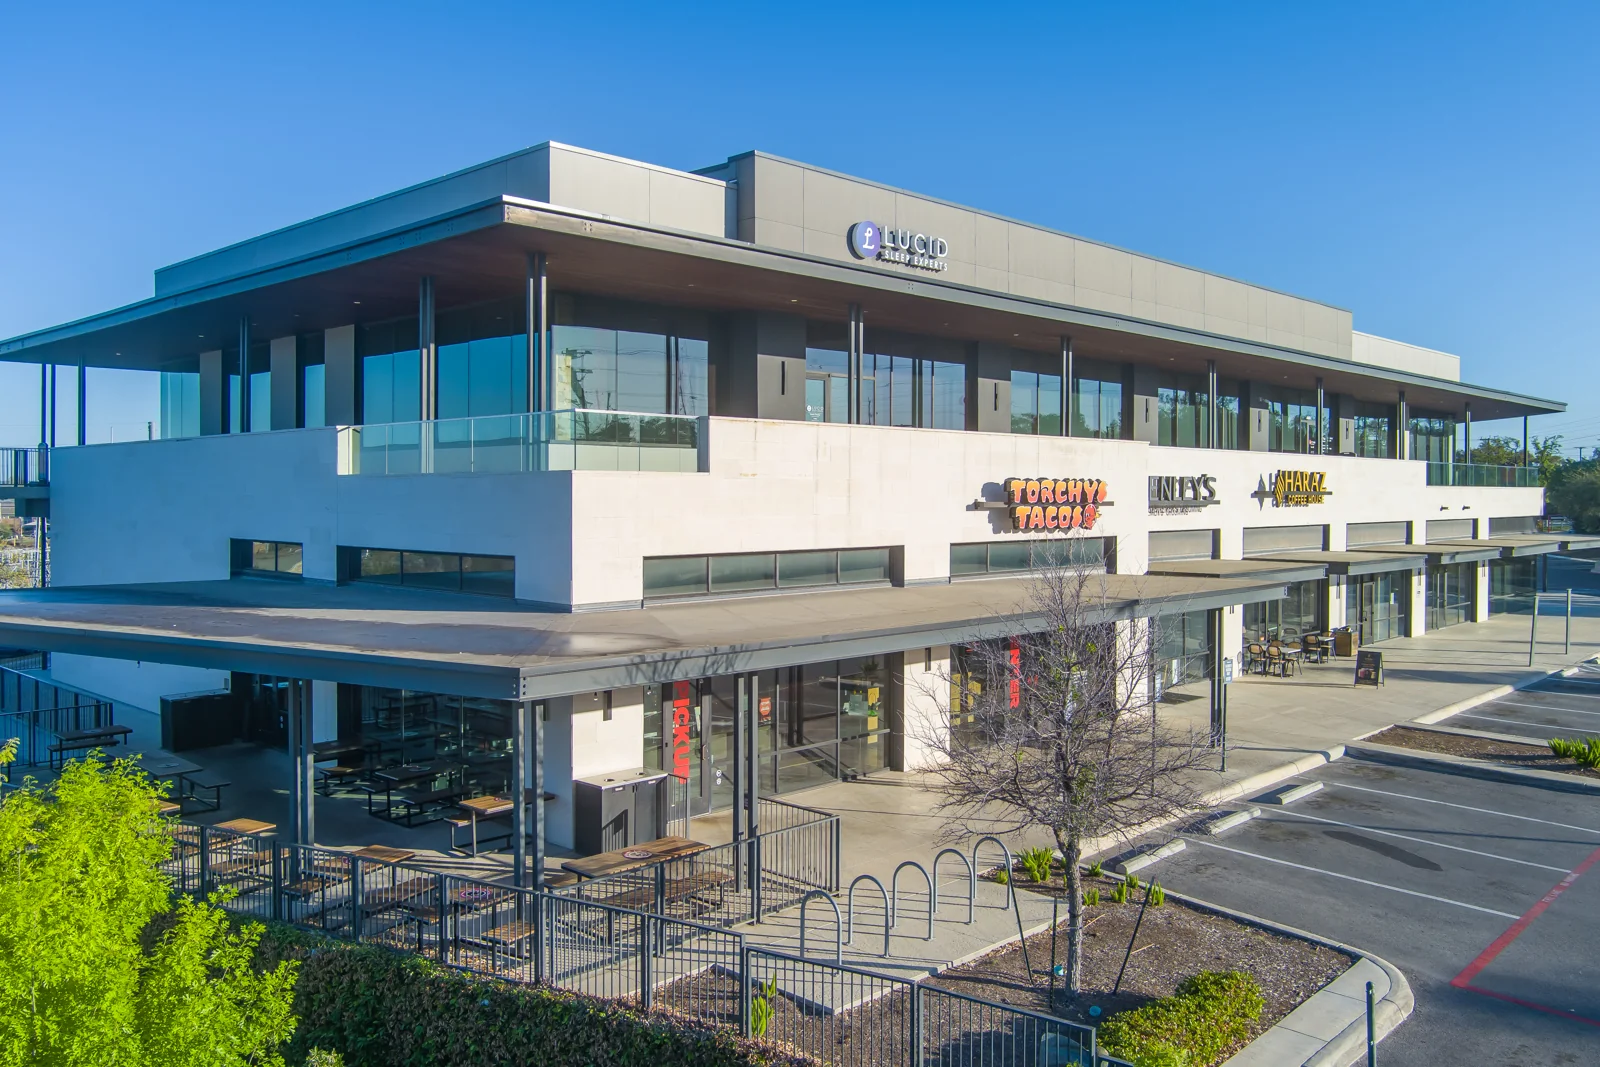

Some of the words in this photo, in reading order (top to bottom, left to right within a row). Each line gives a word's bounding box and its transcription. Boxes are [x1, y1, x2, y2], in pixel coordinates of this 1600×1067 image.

[884, 225, 948, 257] LUCID
[884, 250, 910, 263] SLEEP
[914, 256, 948, 271] EXPERTS
[1285, 470, 1328, 492] HARAZ
[1288, 494, 1308, 505] COFFEE
[1308, 494, 1325, 505] HOUSE
[1015, 505, 1083, 529] TACOS
[673, 680, 690, 785] PICKUP
